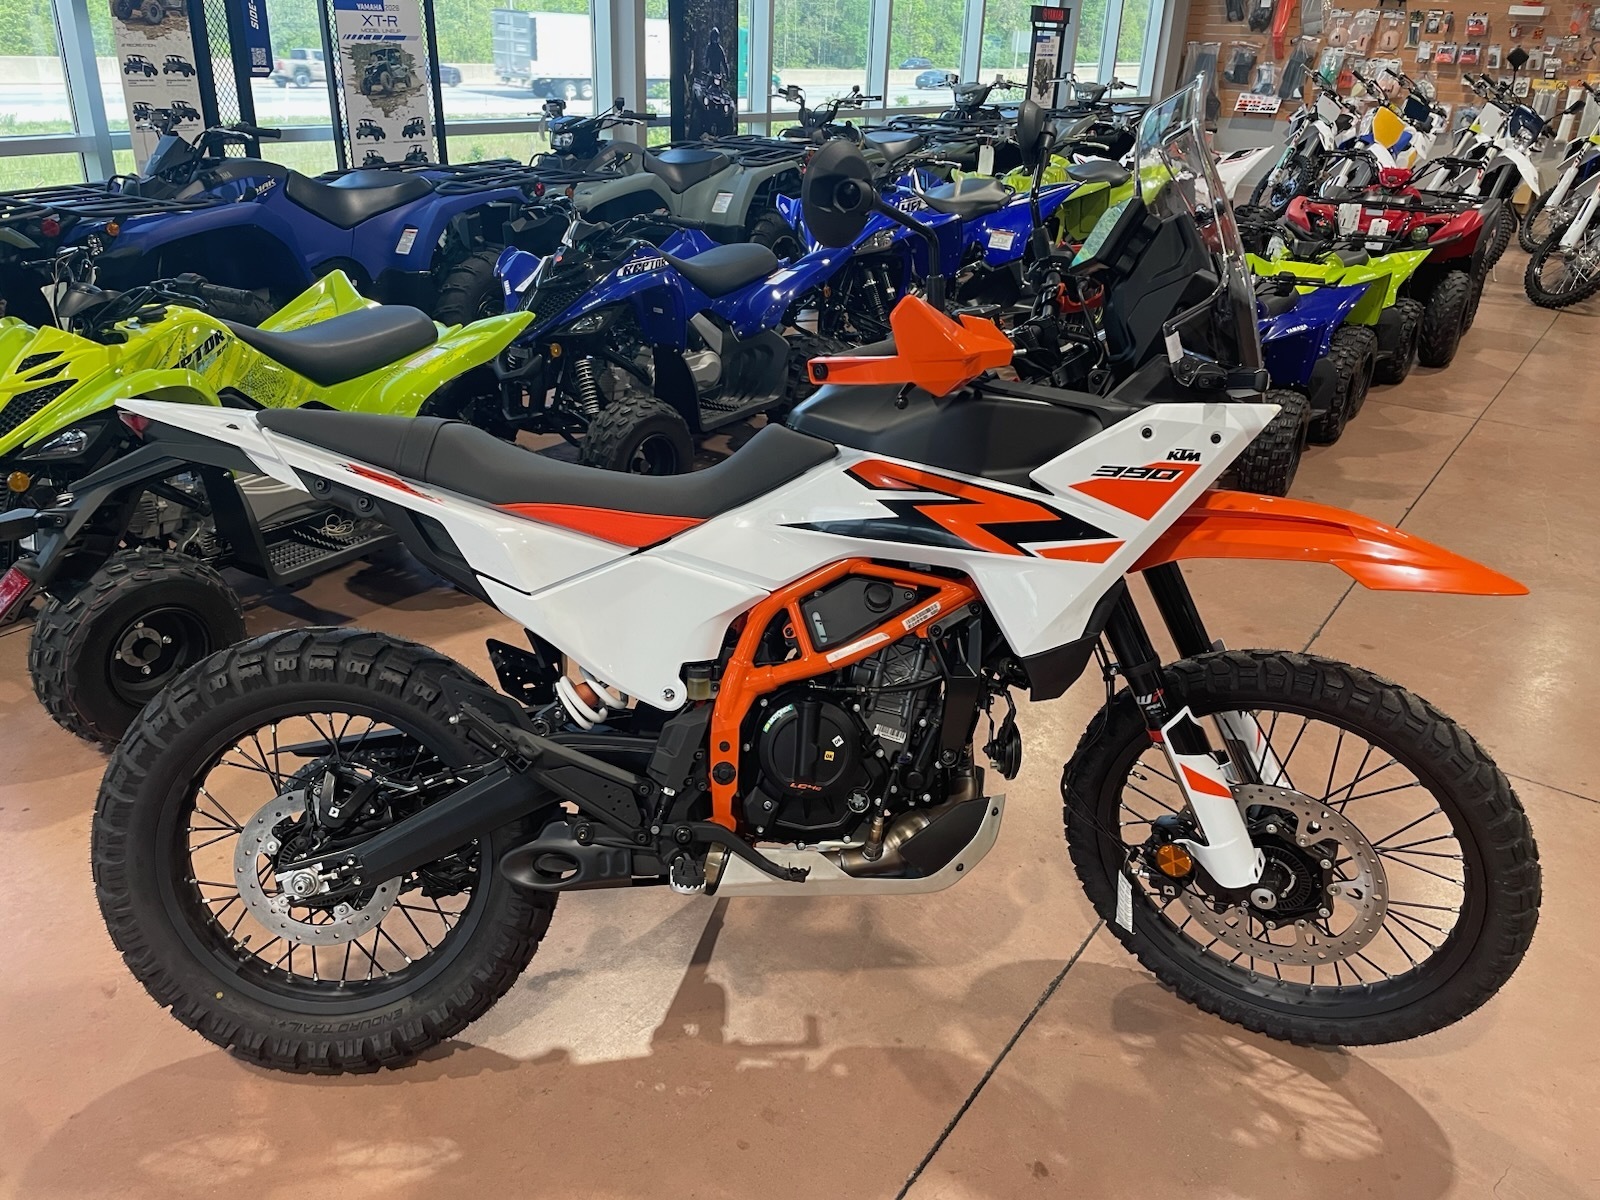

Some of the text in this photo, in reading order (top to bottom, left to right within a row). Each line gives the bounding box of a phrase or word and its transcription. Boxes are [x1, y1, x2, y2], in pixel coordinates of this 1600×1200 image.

[356, 3, 383, 11] YAMAHA
[361, 14, 398, 27] XT-R
[1286, 323, 1309, 334] YAMAHA
[1166, 448, 1201, 462] KTM
[1091, 465, 1184, 481] 390
[337, 1007, 403, 1030] ENDURO
